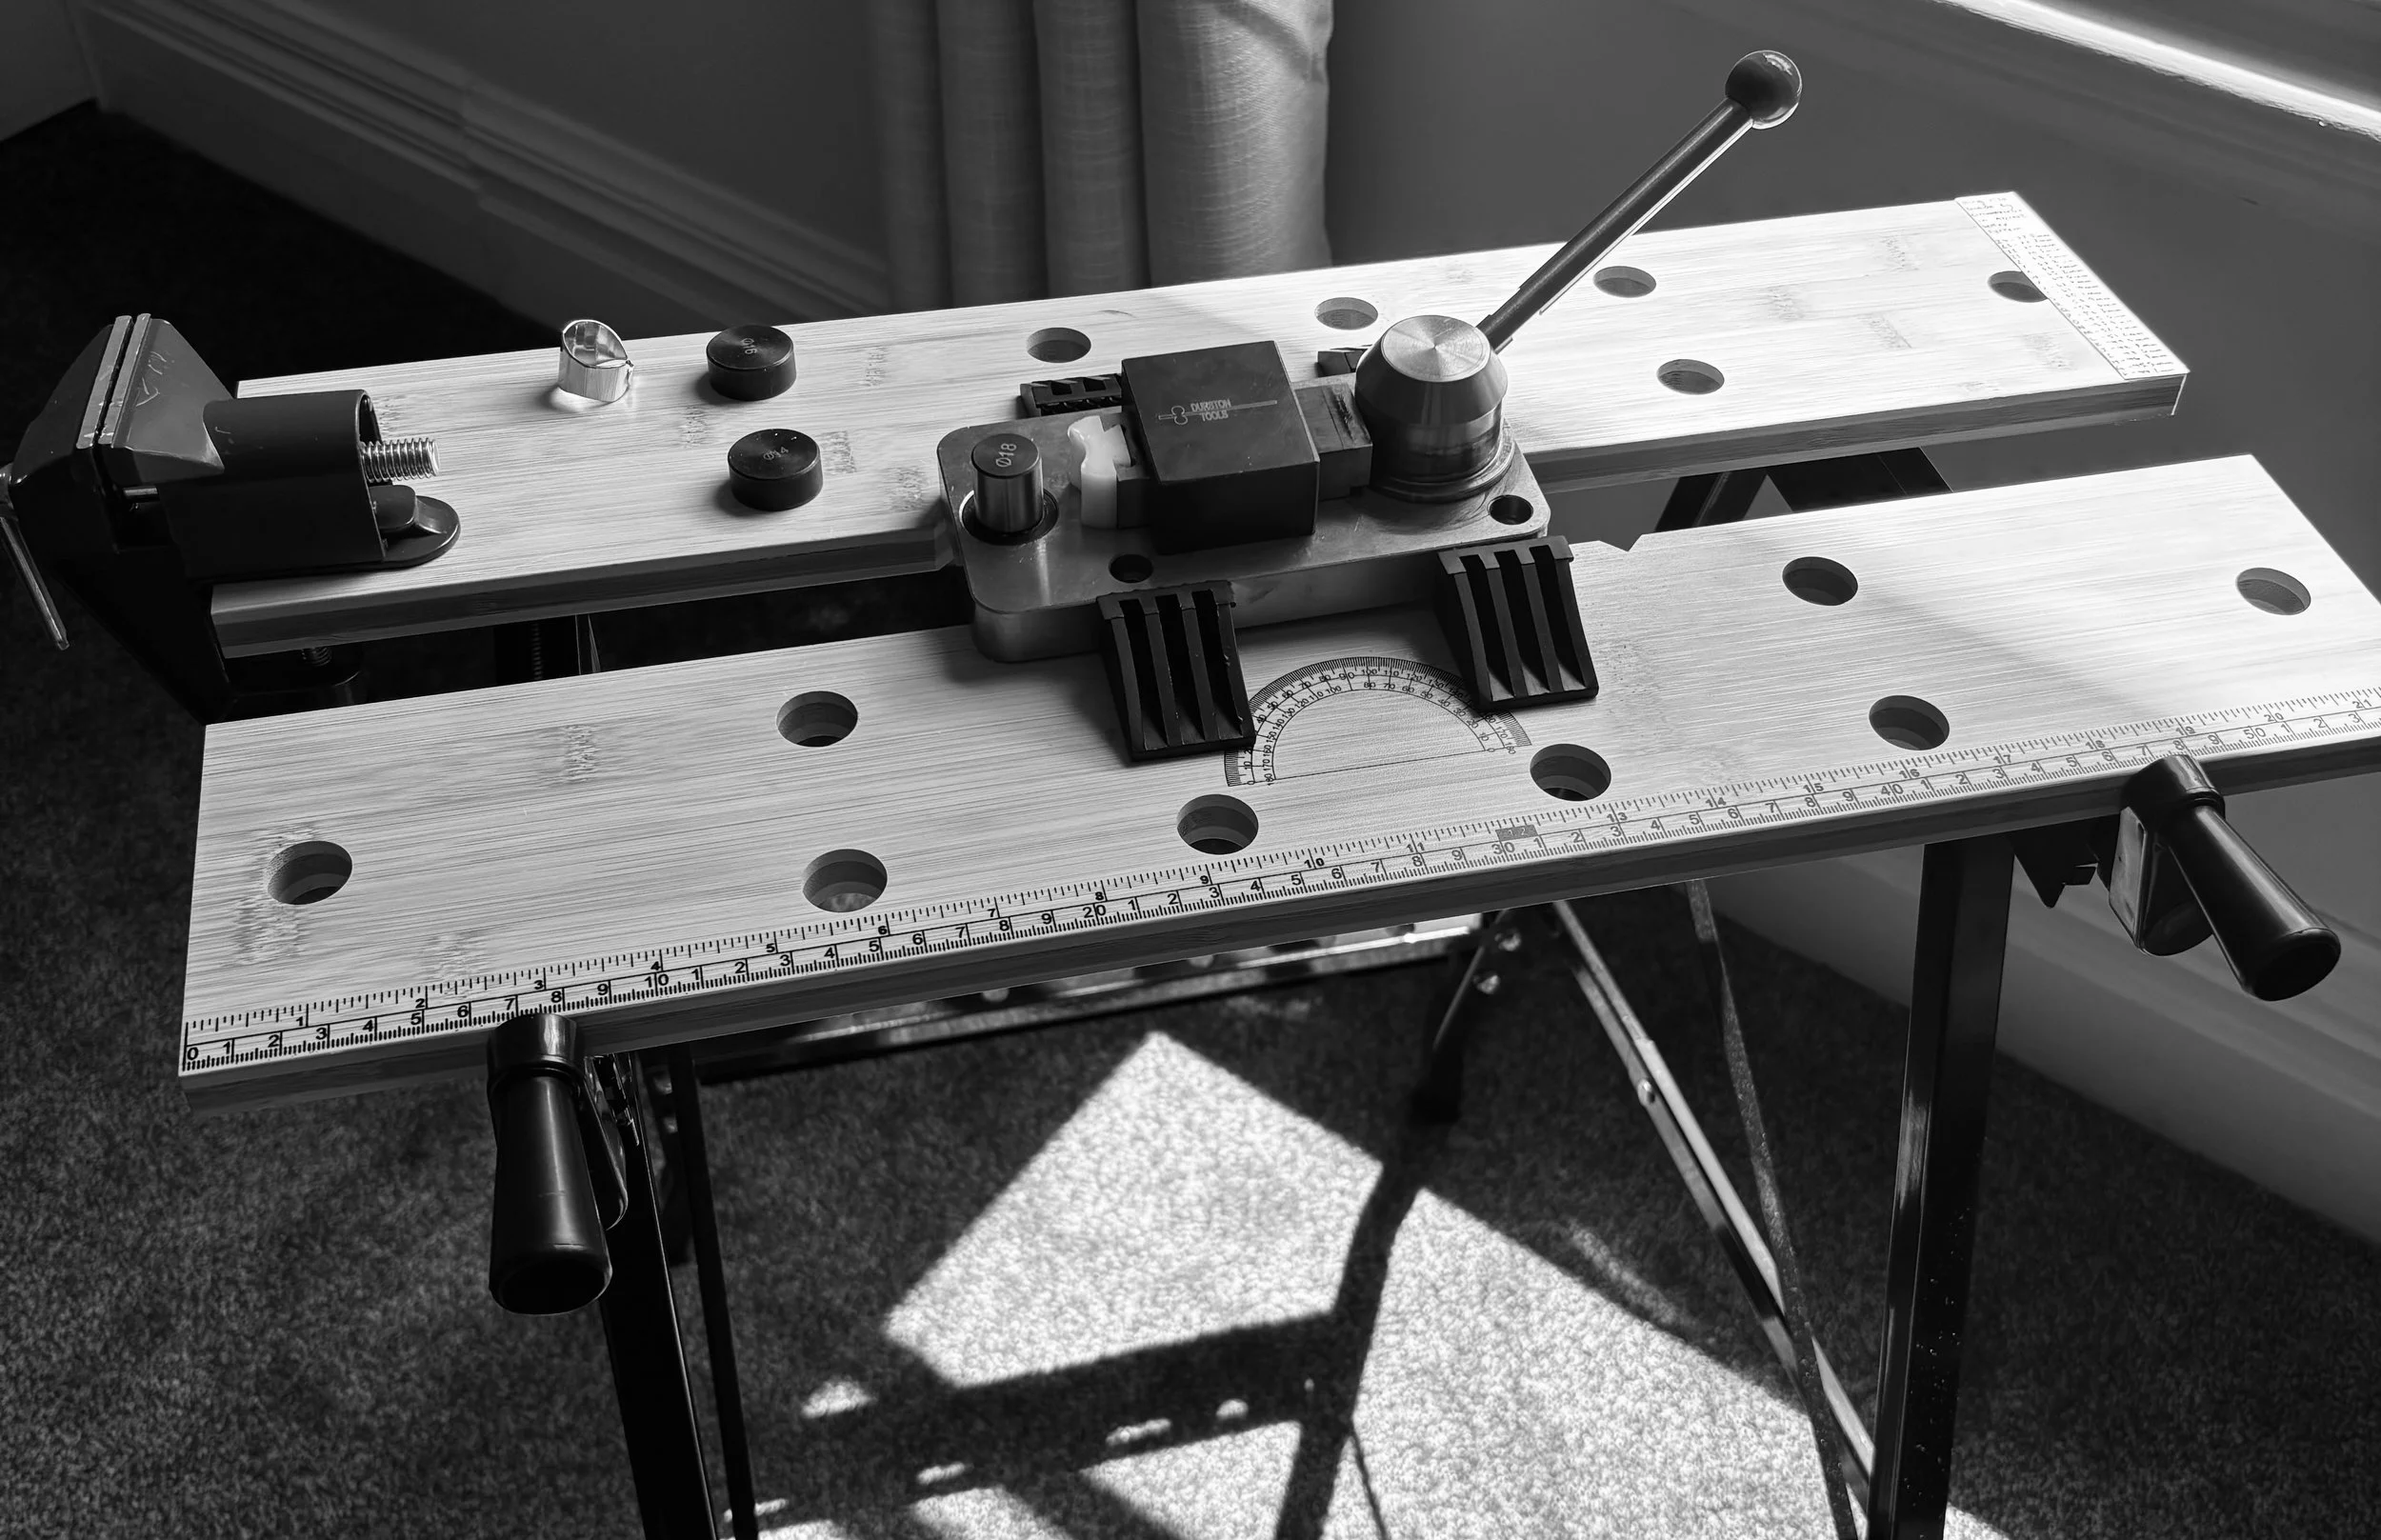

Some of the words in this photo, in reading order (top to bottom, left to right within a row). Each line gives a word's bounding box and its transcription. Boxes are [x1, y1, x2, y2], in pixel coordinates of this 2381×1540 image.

[1190, 398, 1232, 412] DURSTON
[1200, 410, 1230, 422] TOOLS
[1325, 685, 1342, 695] 100
[1401, 685, 1415, 693] 60
[1420, 690, 1433, 699] 50
[1294, 698, 1310, 709] 120
[1437, 698, 1451, 708] 40
[1281, 708, 1296, 719] 130
[1452, 708, 1467, 717] 30
[1243, 760, 1253, 770] 10
[1267, 700, 1279, 710] 50
[1281, 690, 1294, 699] 60
[1298, 680, 1312, 690] 70
[1318, 674, 1331, 683] 80
[1338, 671, 1355, 681] 90
[1406, 672, 1423, 682] 120
[1495, 726, 1509, 739] 170
[1504, 742, 1516, 755] 180
[1272, 718, 1286, 731] 140
[1466, 718, 1479, 729] 20
[1266, 730, 1277, 744] 150
[1478, 731, 1490, 742] 10
[1263, 744, 1272, 758] 160
[1262, 758, 1271, 771] 170
[295, 1016, 304, 1027] 1
[414, 998, 426, 1010] 2
[533, 979, 545, 990] 3
[650, 961, 661, 971] 4
[766, 943, 776, 953] 5
[877, 925, 889, 935] 6
[987, 908, 996, 918] 7
[1095, 891, 1105, 901] 8
[1199, 875, 1210, 885] 9
[1304, 857, 1325, 870] 10
[1406, 842, 1426, 853] 11
[1606, 811, 1629, 823] 13
[1705, 796, 1727, 809] 14
[1802, 781, 1825, 793] 15
[1898, 768, 1921, 780] 16
[1992, 753, 2012, 765] 17
[2085, 739, 2106, 750] 18
[2174, 726, 2196, 737] 19
[2263, 712, 2284, 723] 20
[2351, 698, 2373, 709] 21
[186, 1046, 199, 1061] 0
[222, 1042, 232, 1055] 1
[268, 1034, 280, 1048] 2
[315, 1027, 328, 1040] 3
[362, 1019, 374, 1031] 4
[410, 1012, 422, 1026] 5
[456, 1005, 470, 1018] 6
[504, 998, 515, 1010] 7
[550, 990, 563, 1003] 8
[596, 983, 610, 996] 9
[644, 973, 670, 988] 10
[690, 968, 700, 981] 1
[734, 961, 746, 974] 2
[779, 954, 791, 967] 3
[824, 947, 835, 958] 4
[869, 940, 880, 952] 5
[911, 932, 924, 946] 6
[954, 926, 966, 938] 7
[998, 919, 1010, 931] 8
[1040, 912, 1052, 925] 9
[1082, 905, 1107, 918] 20
[1127, 899, 1137, 910] 1
[1167, 892, 1179, 906] 2
[1208, 887, 1220, 899] 3
[1250, 880, 1261, 891] 4
[1291, 874, 1302, 887] 5
[1331, 867, 1343, 880] 6
[1371, 861, 1381, 873] 7
[1411, 855, 1423, 868] 8
[1451, 849, 1463, 861] 9
[1491, 841, 1516, 855] 30
[1532, 836, 1543, 849] 1
[1571, 830, 1583, 843] 2
[1610, 825, 1622, 838] 3
[1650, 819, 1662, 830] 4
[1688, 813, 1701, 826] 5
[1727, 808, 1740, 820] 6
[1765, 802, 1776, 814] 7
[1803, 796, 1817, 809] 8
[1842, 790, 1855, 802] 9
[1880, 782, 1904, 796] 40
[1920, 778, 1931, 790] 1
[1955, 772, 1968, 785] 2
[1991, 767, 2006, 779] 3
[2030, 761, 2041, 773] 4
[2065, 755, 2078, 768] 5
[2102, 750, 2114, 762] 6
[2136, 744, 2149, 756] 7
[2172, 738, 2185, 751] 8
[2208, 732, 2221, 746] 9
[2243, 727, 2267, 740] 50
[2280, 722, 2291, 734] 1
[2312, 716, 2327, 730] 2
[2348, 711, 2361, 724] 3
